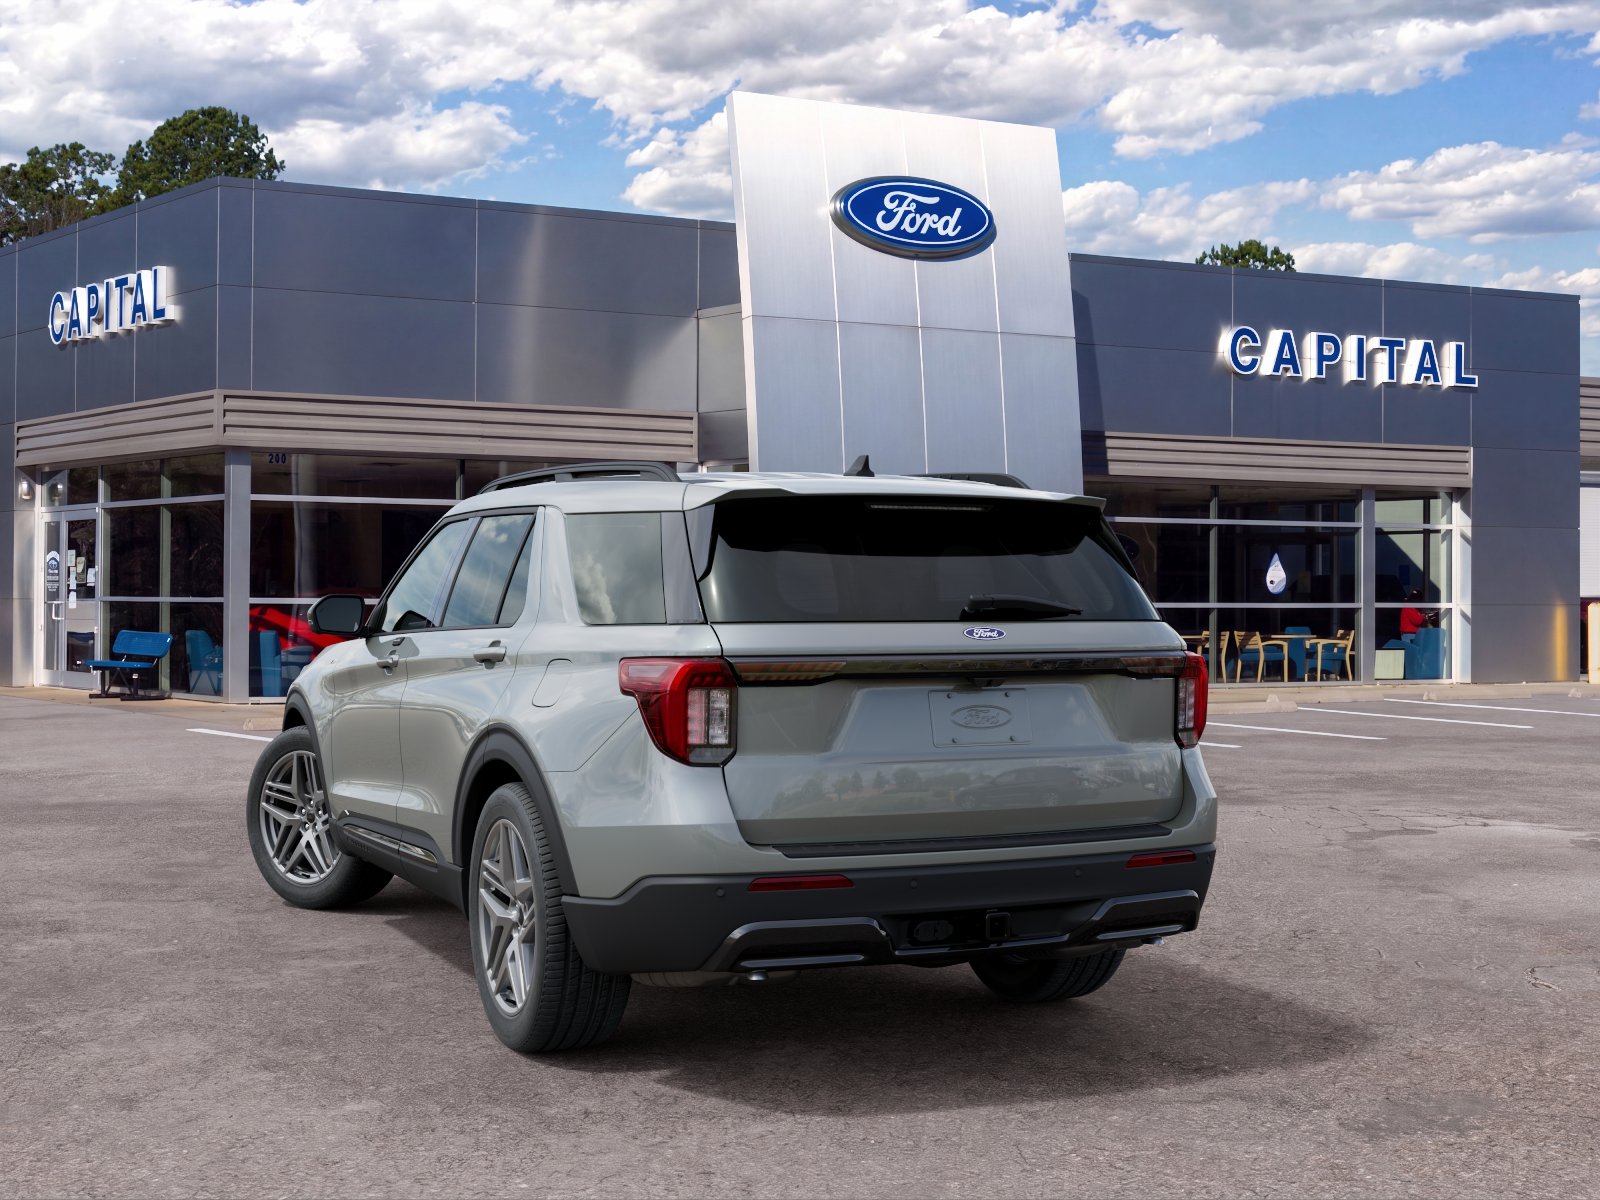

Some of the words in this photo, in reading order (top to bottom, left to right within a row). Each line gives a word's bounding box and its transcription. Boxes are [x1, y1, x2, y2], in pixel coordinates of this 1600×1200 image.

[876, 190, 963, 237] Ford
[49, 266, 169, 345] CAPITAL
[1227, 326, 1479, 388] CAPITAL
[268, 453, 287, 464] 200
[973, 628, 999, 638] Ford
[964, 708, 1000, 725] Ford
